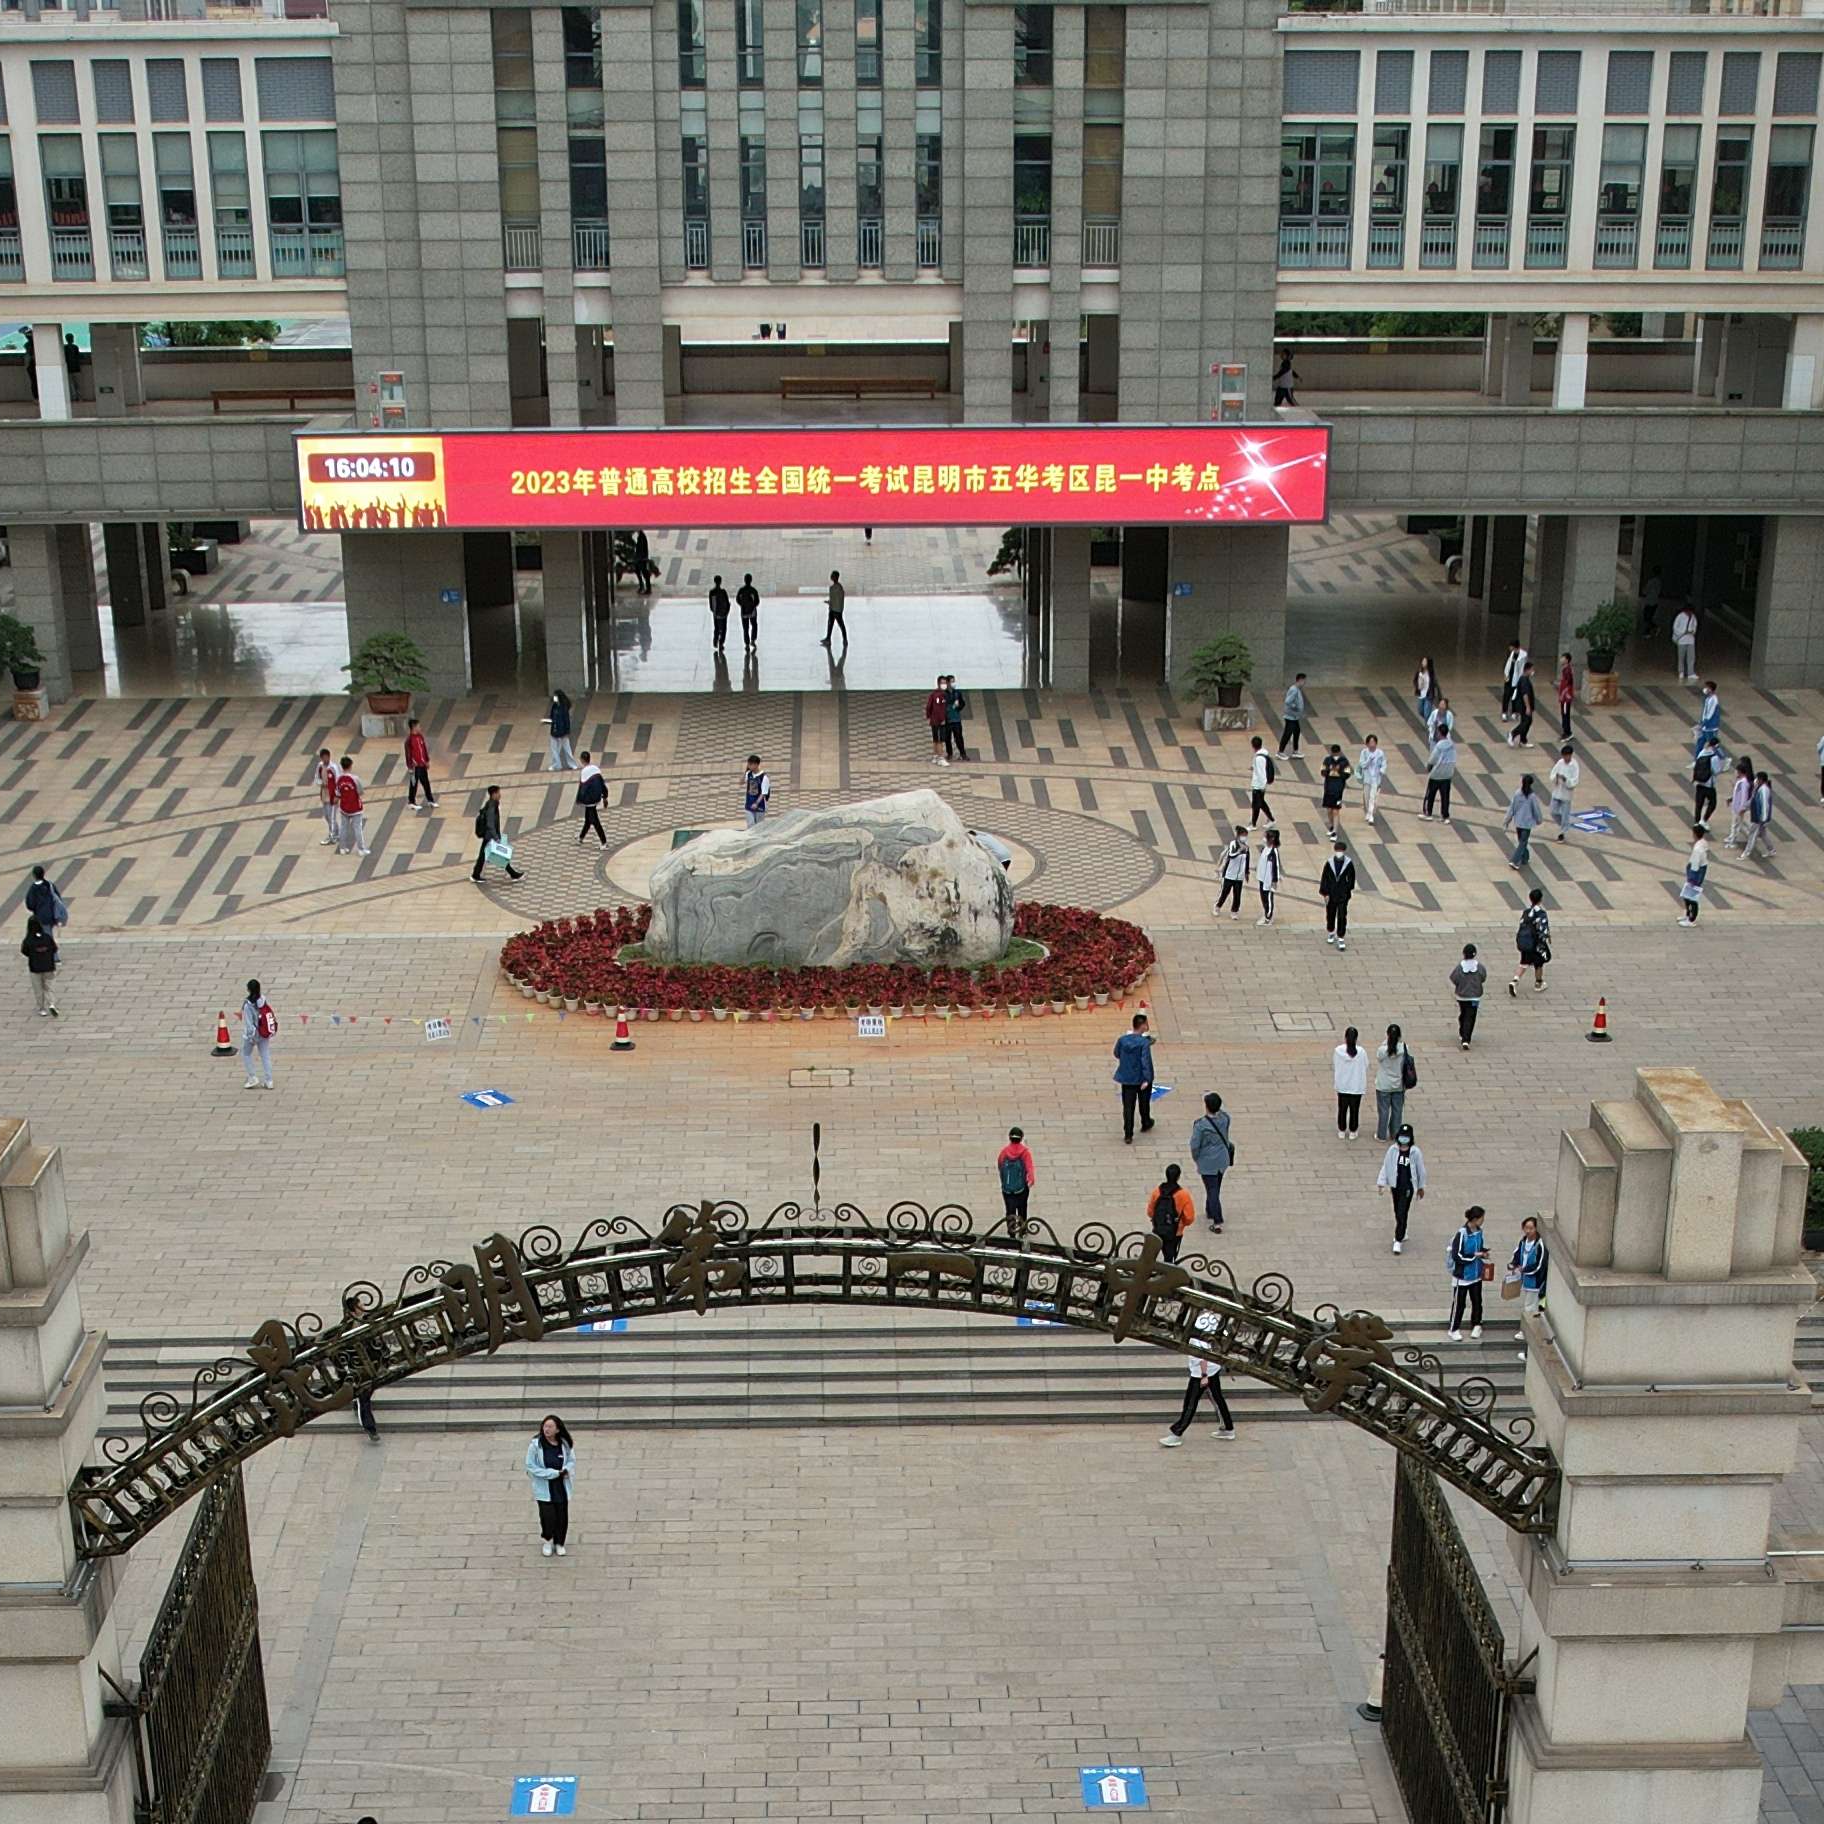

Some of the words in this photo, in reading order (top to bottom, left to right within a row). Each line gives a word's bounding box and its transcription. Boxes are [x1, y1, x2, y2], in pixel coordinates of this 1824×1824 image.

[324, 456, 415, 478] 16:04:10
[511, 463, 1221, 496] 2023年普通高校招生全国统一考试昆明市五华考区昆一中考点
